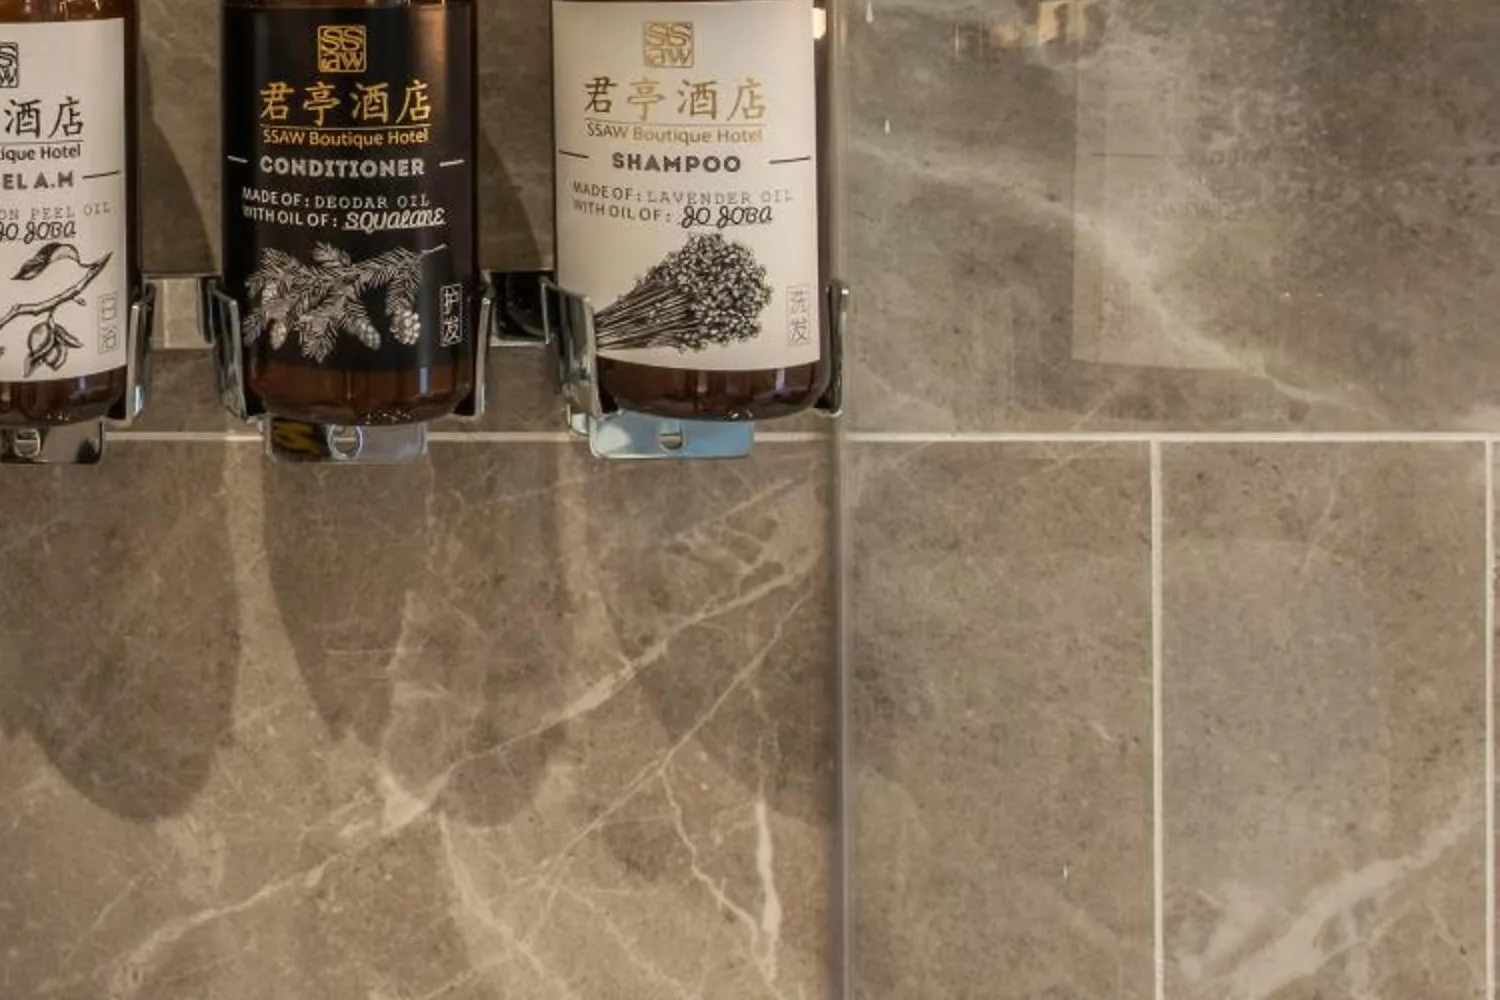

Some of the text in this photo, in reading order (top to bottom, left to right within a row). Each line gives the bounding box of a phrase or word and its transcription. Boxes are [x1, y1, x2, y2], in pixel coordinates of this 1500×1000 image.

[259, 79, 432, 126] 君亭酒店
[583, 76, 766, 122] 君亭酒店
[263, 128, 428, 149] SSAW Boutique Hotel
[587, 122, 763, 146] SSAW Boutique Hotel
[40, 144, 81, 158] Hotel
[260, 156, 425, 178] CONDITIONER
[612, 152, 741, 173] SHAMPOO
[34, 171, 74, 189] A.M
[242, 186, 281, 204] MADE
[315, 196, 389, 209] DEODAR
[397, 195, 430, 208] OIL
[572, 181, 610, 199] MADE
[646, 191, 750, 205] LAVENDER
[761, 189, 792, 202] OIL
[31, 206, 75, 220] PEEL
[84, 202, 111, 215] OIL
[242, 206, 277, 222] WITH
[277, 210, 304, 225] OIL
[572, 200, 606, 217] WITH
[609, 205, 634, 220] OIL
